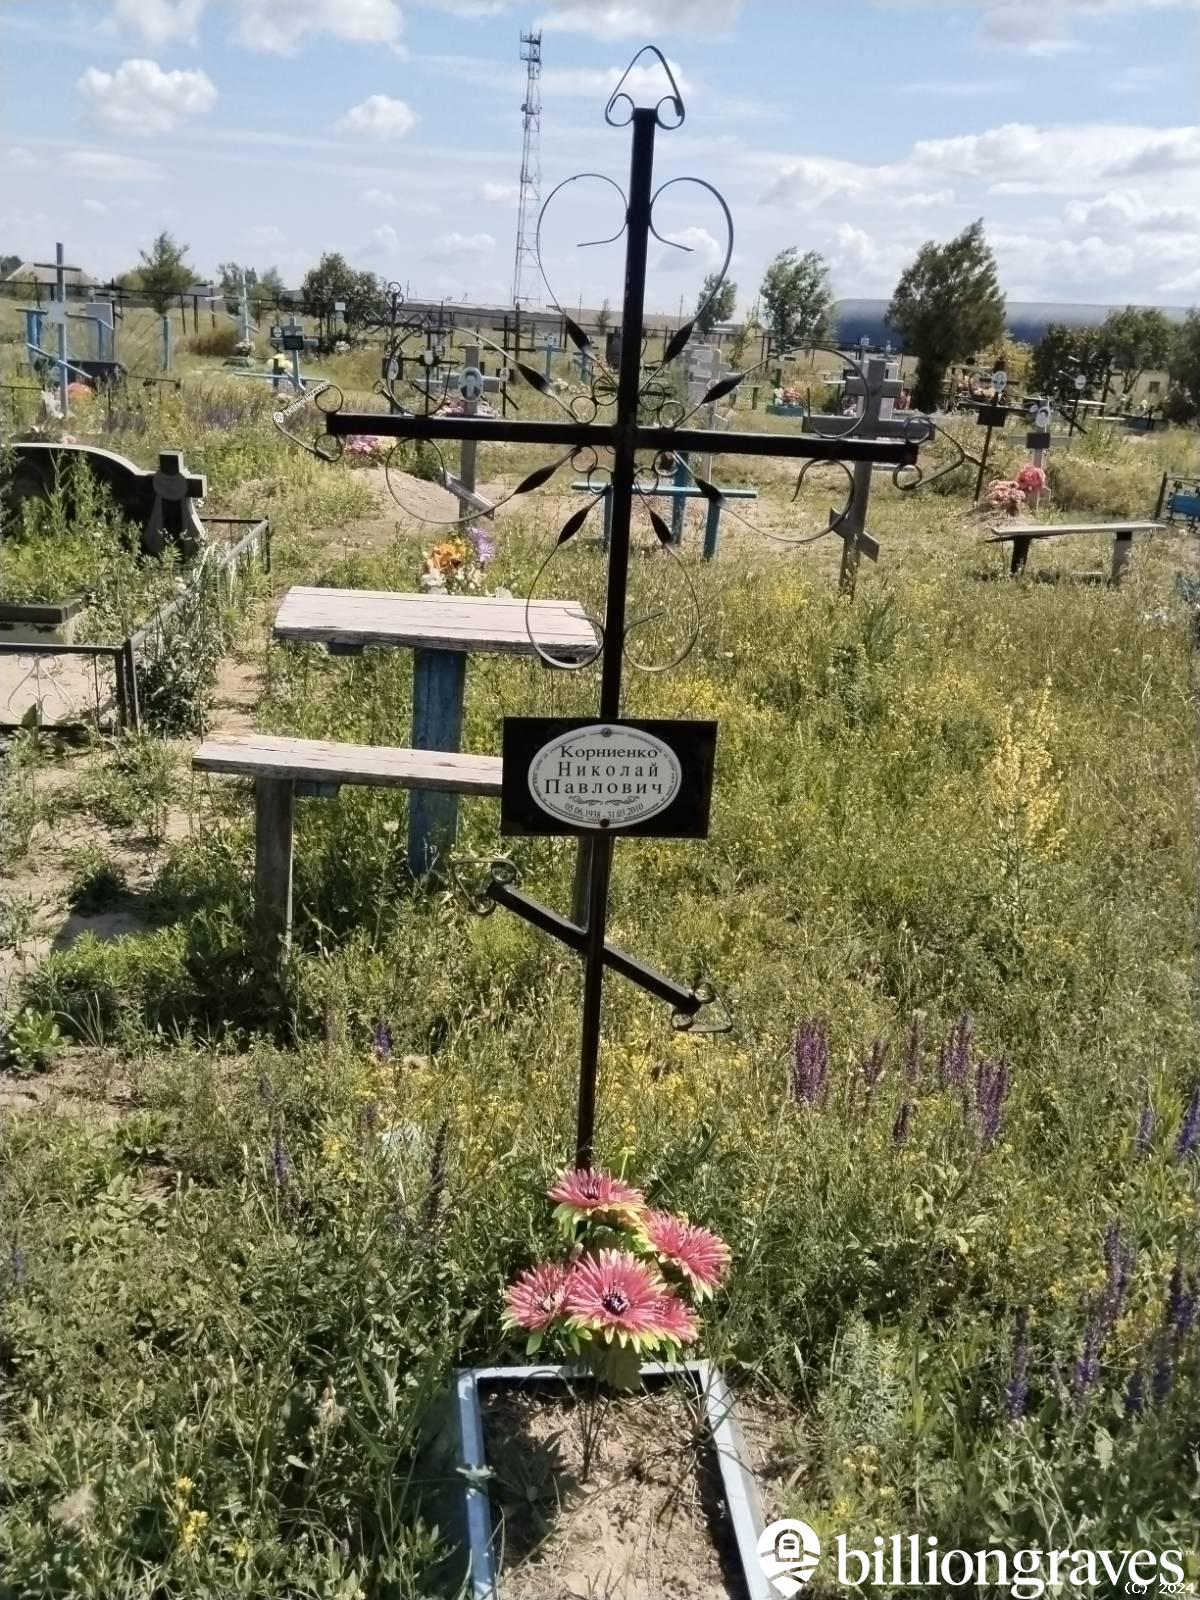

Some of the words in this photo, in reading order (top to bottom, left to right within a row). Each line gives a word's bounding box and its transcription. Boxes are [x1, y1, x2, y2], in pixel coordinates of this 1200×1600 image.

[560, 746, 658, 761] Корниенко
[558, 762, 658, 777] Николай
[544, 779, 662, 794] Павлович
